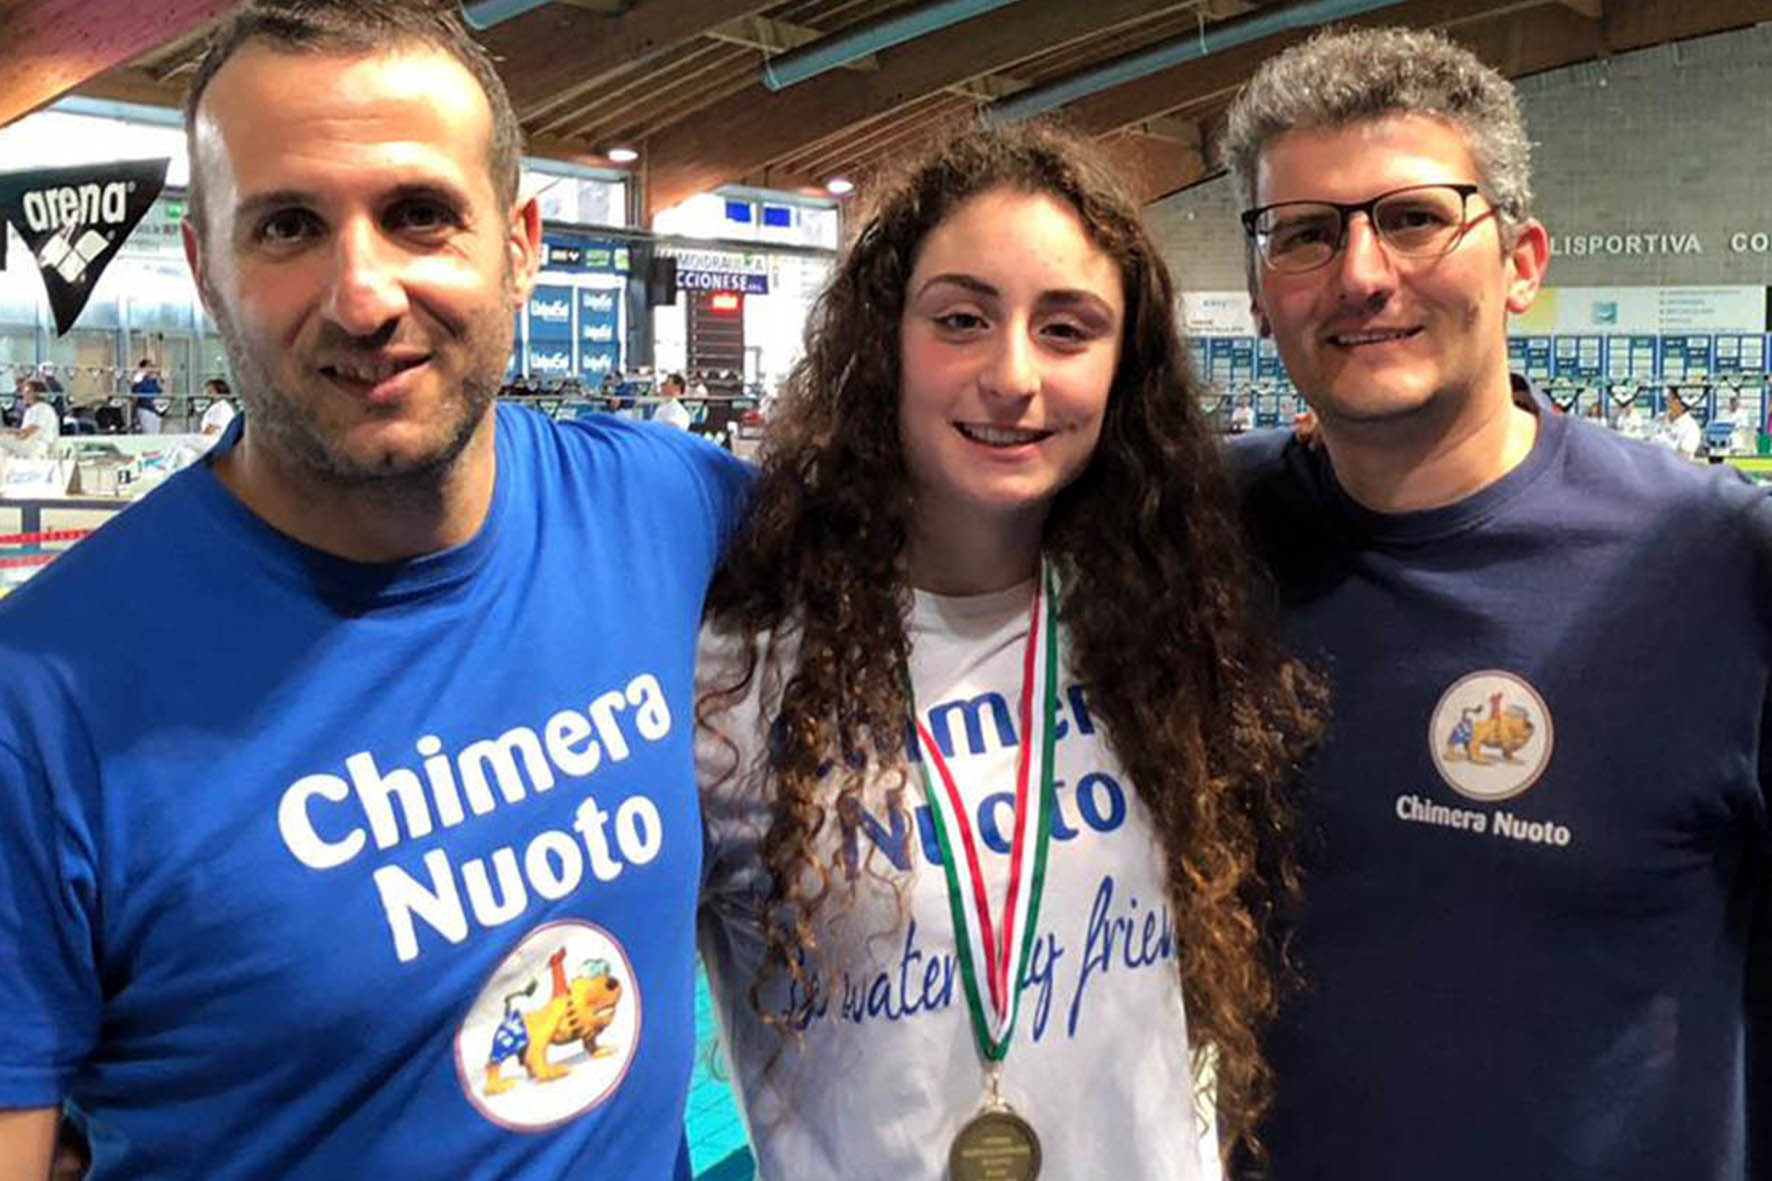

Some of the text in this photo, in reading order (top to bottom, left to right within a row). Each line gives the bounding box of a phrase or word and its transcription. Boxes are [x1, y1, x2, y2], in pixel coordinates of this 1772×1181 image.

[22, 181, 127, 233] arena
[1550, 231, 1771, 255] LISPORTIVA CO
[676, 271, 748, 292] CCIONESE
[278, 673, 672, 870] Chimera
[1395, 794, 1572, 847] Chimera Nuoto
[373, 795, 662, 964] Nuoto
